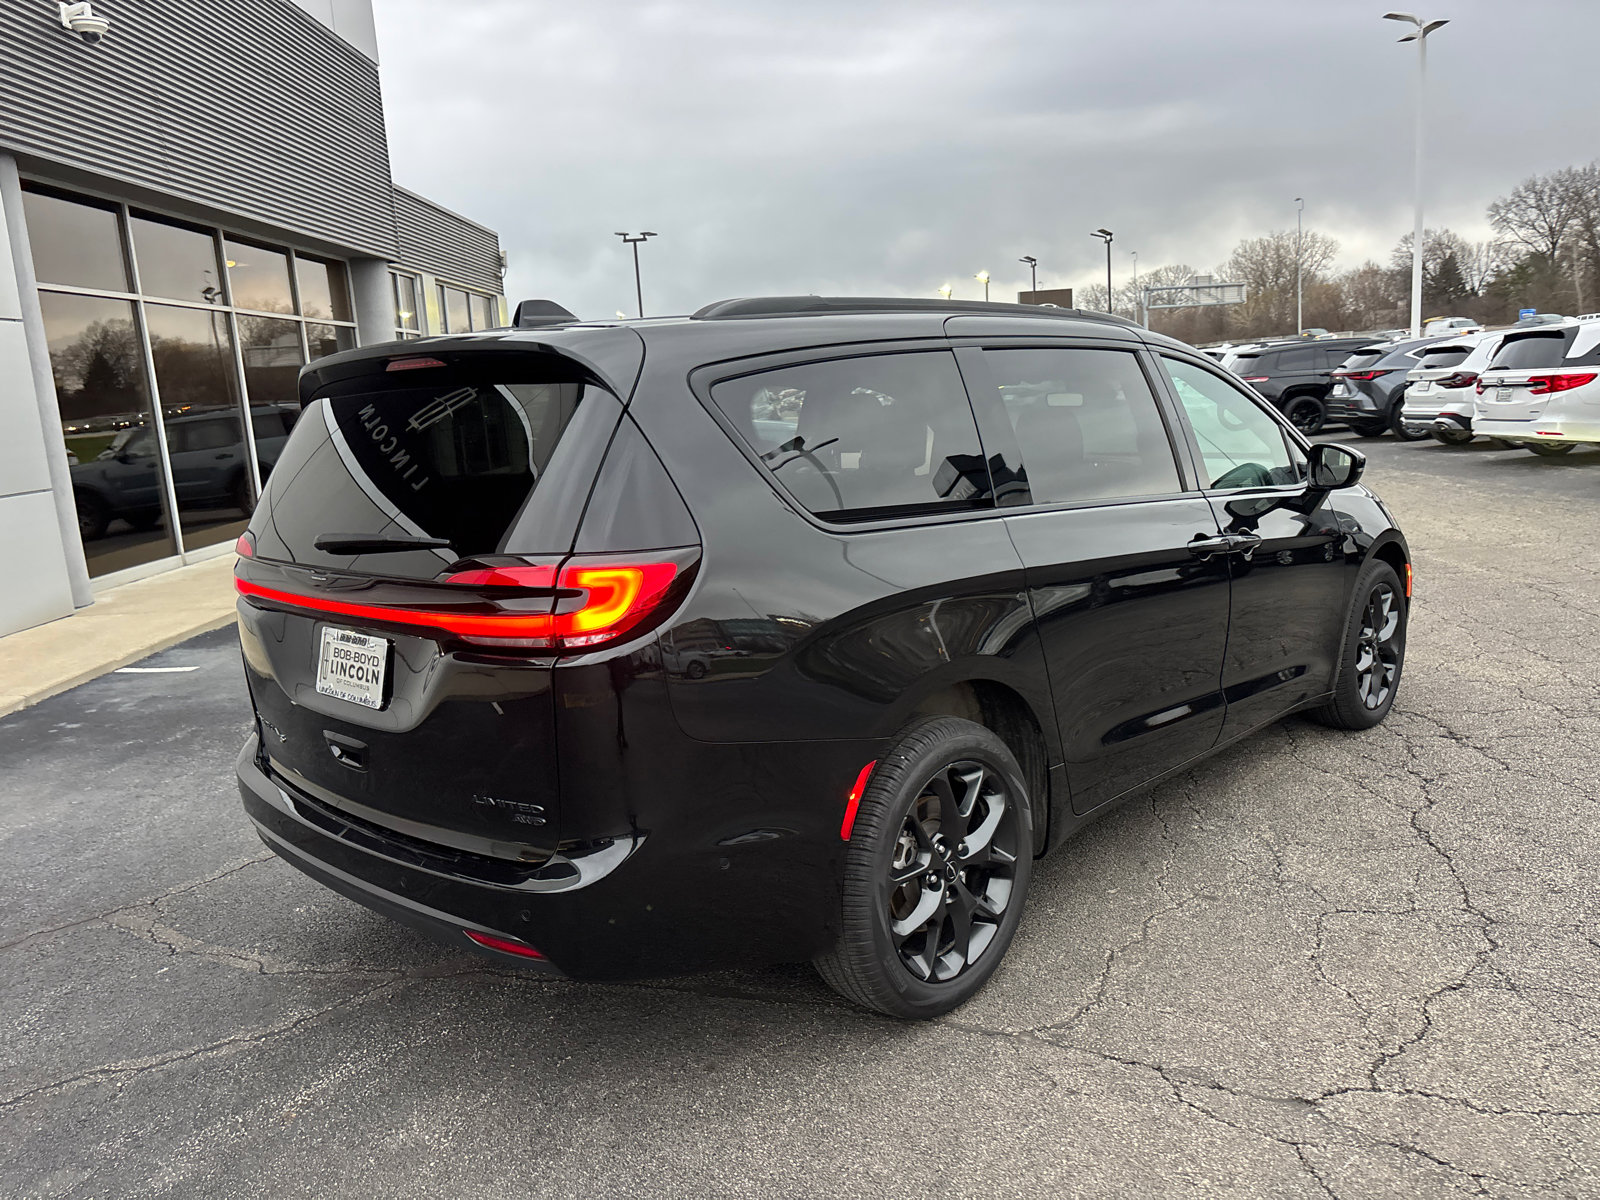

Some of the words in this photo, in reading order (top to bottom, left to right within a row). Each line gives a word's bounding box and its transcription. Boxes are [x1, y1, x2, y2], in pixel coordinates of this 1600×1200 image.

[333, 647, 380, 667] BOB-BOYD
[330, 660, 380, 685] LINCOLN
[344, 679, 370, 691] COLUMBUS
[472, 794, 545, 814] LIMITED
[512, 813, 547, 827] AWD
